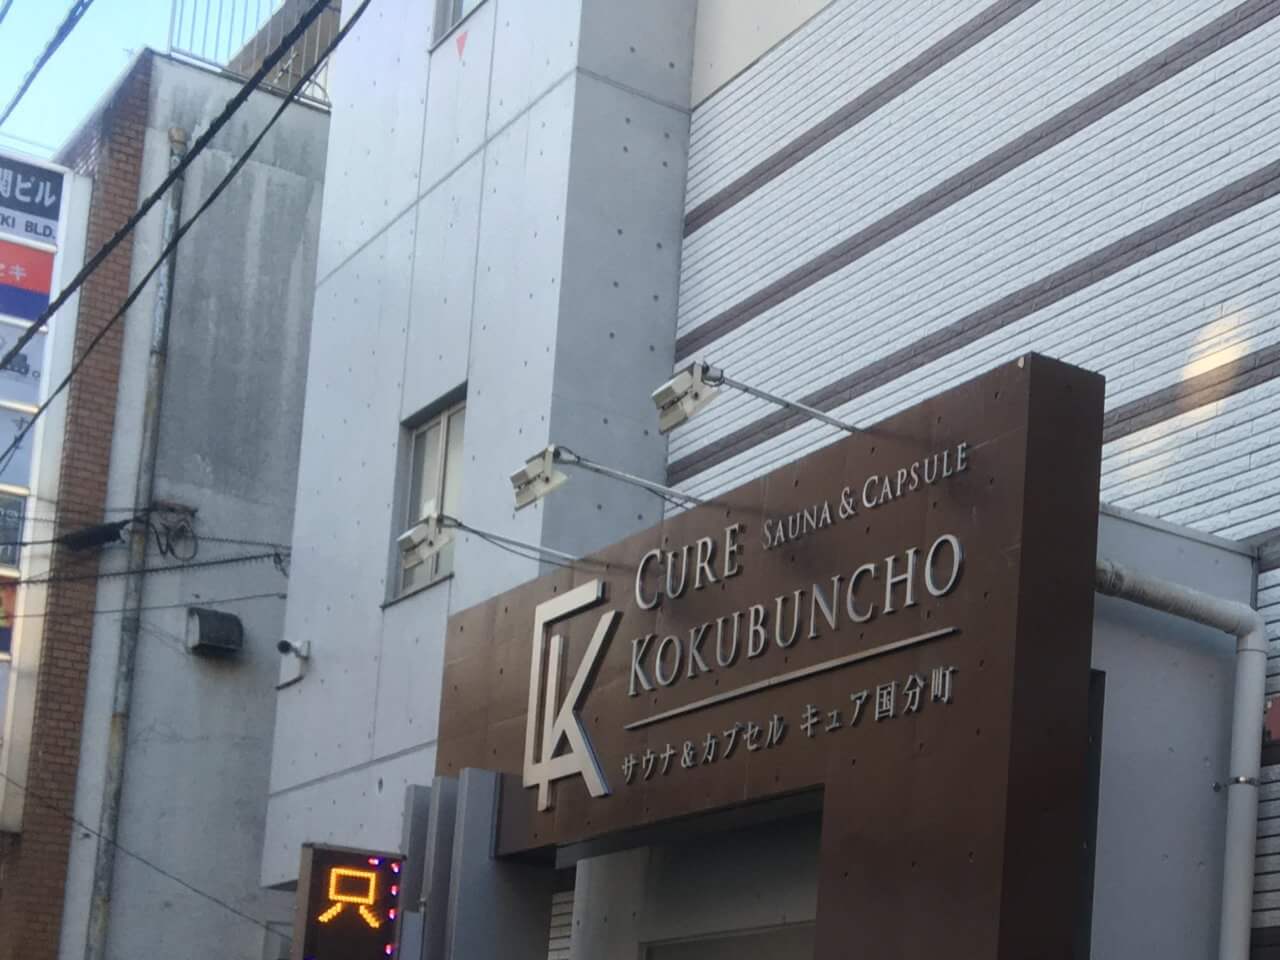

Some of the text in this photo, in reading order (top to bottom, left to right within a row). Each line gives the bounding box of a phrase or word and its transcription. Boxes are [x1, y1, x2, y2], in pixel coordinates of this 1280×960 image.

[635, 442, 969, 611] CURE SAUNA & CAPSULE
[628, 533, 966, 697] KOKUBUNCHO
